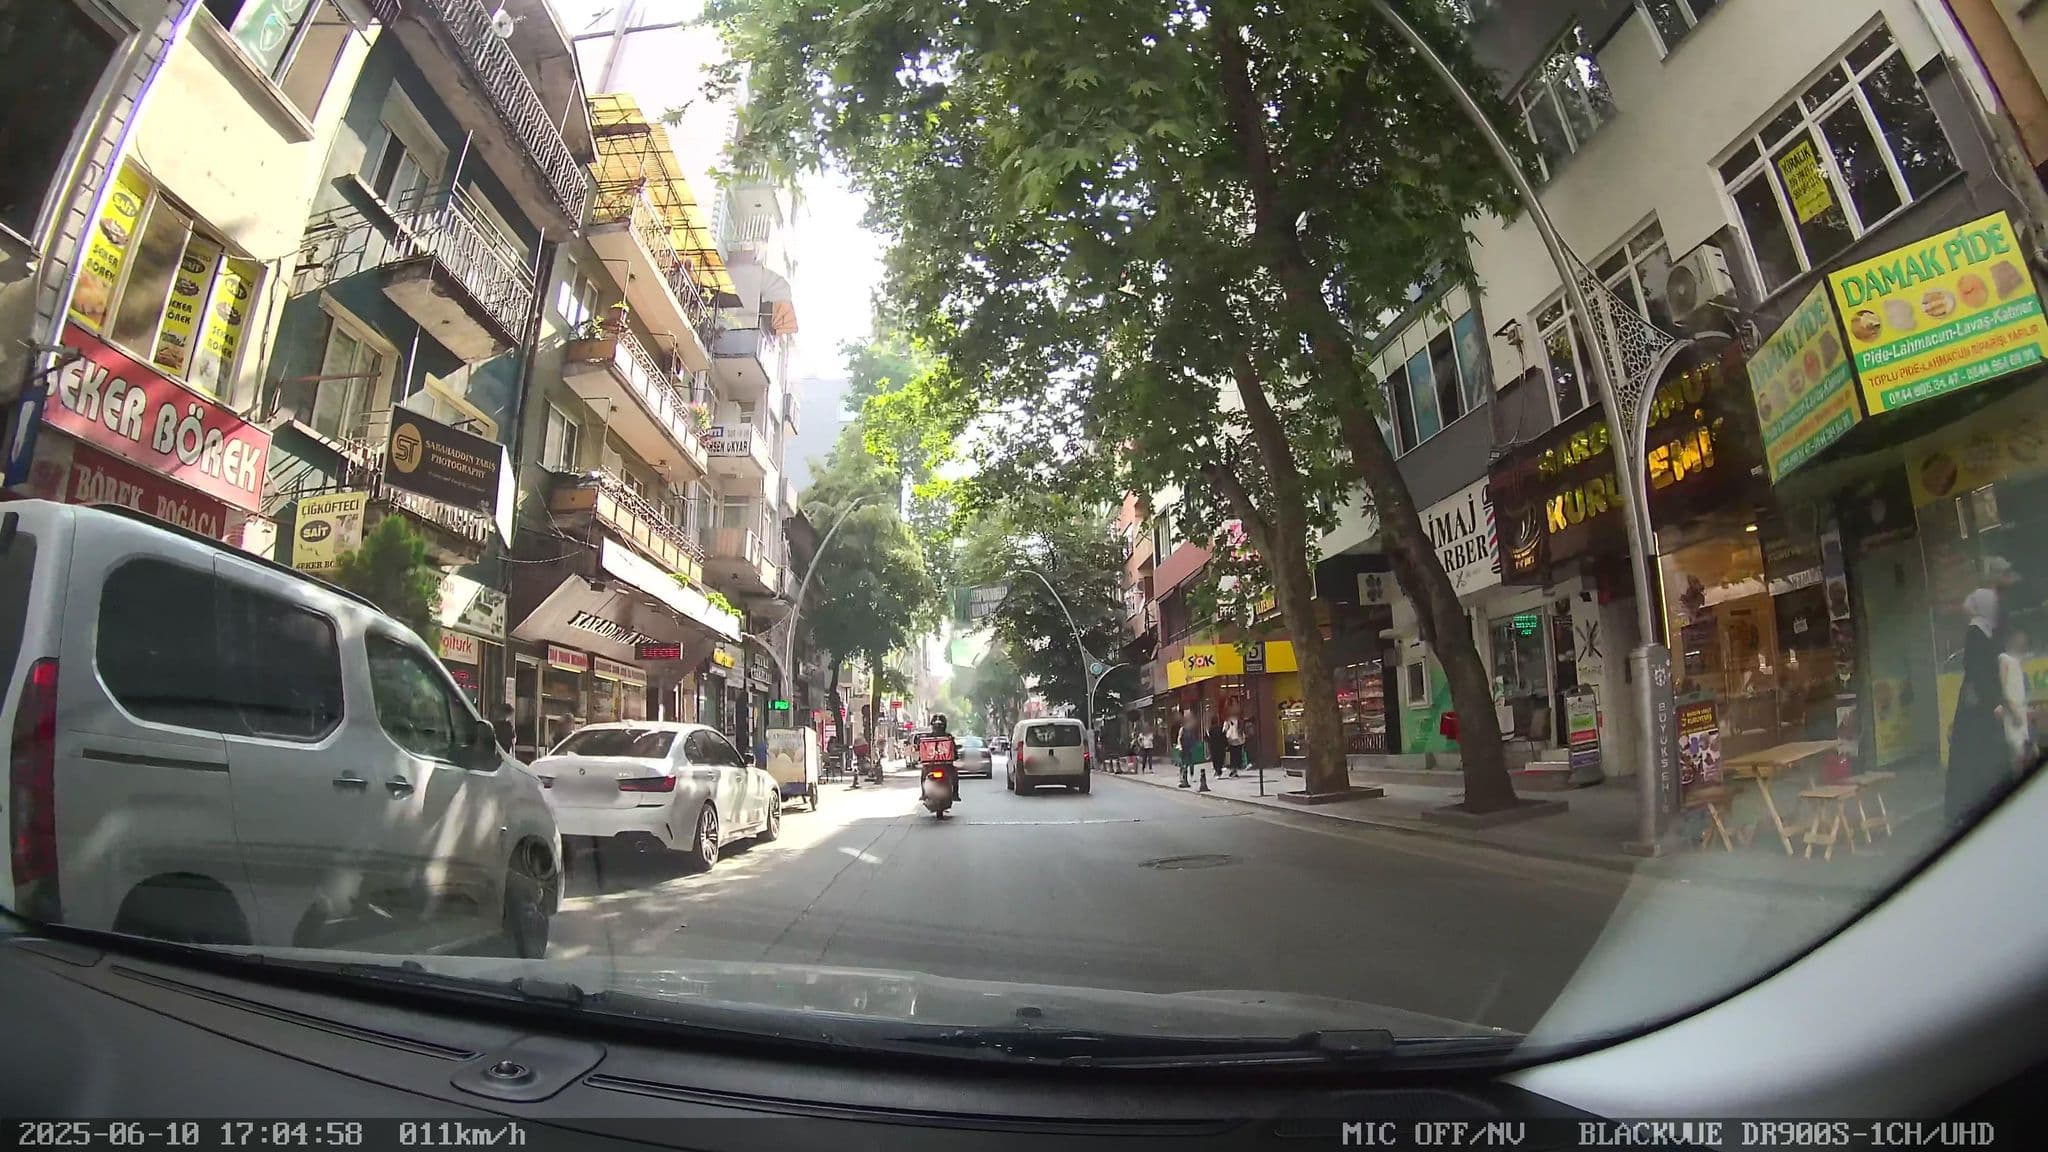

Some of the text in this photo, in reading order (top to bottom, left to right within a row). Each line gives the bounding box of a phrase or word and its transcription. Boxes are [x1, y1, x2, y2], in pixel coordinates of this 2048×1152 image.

[1841, 222, 2010, 307] DAMAK PİDE
[152, 402, 261, 493] BÖREK
[431, 453, 486, 479] PHOTOGRAPHY
[74, 462, 144, 510] BÖREK
[303, 525, 329, 538] SAİT
[1428, 493, 1476, 548] İMAJ
[1442, 534, 1489, 573] RBER
